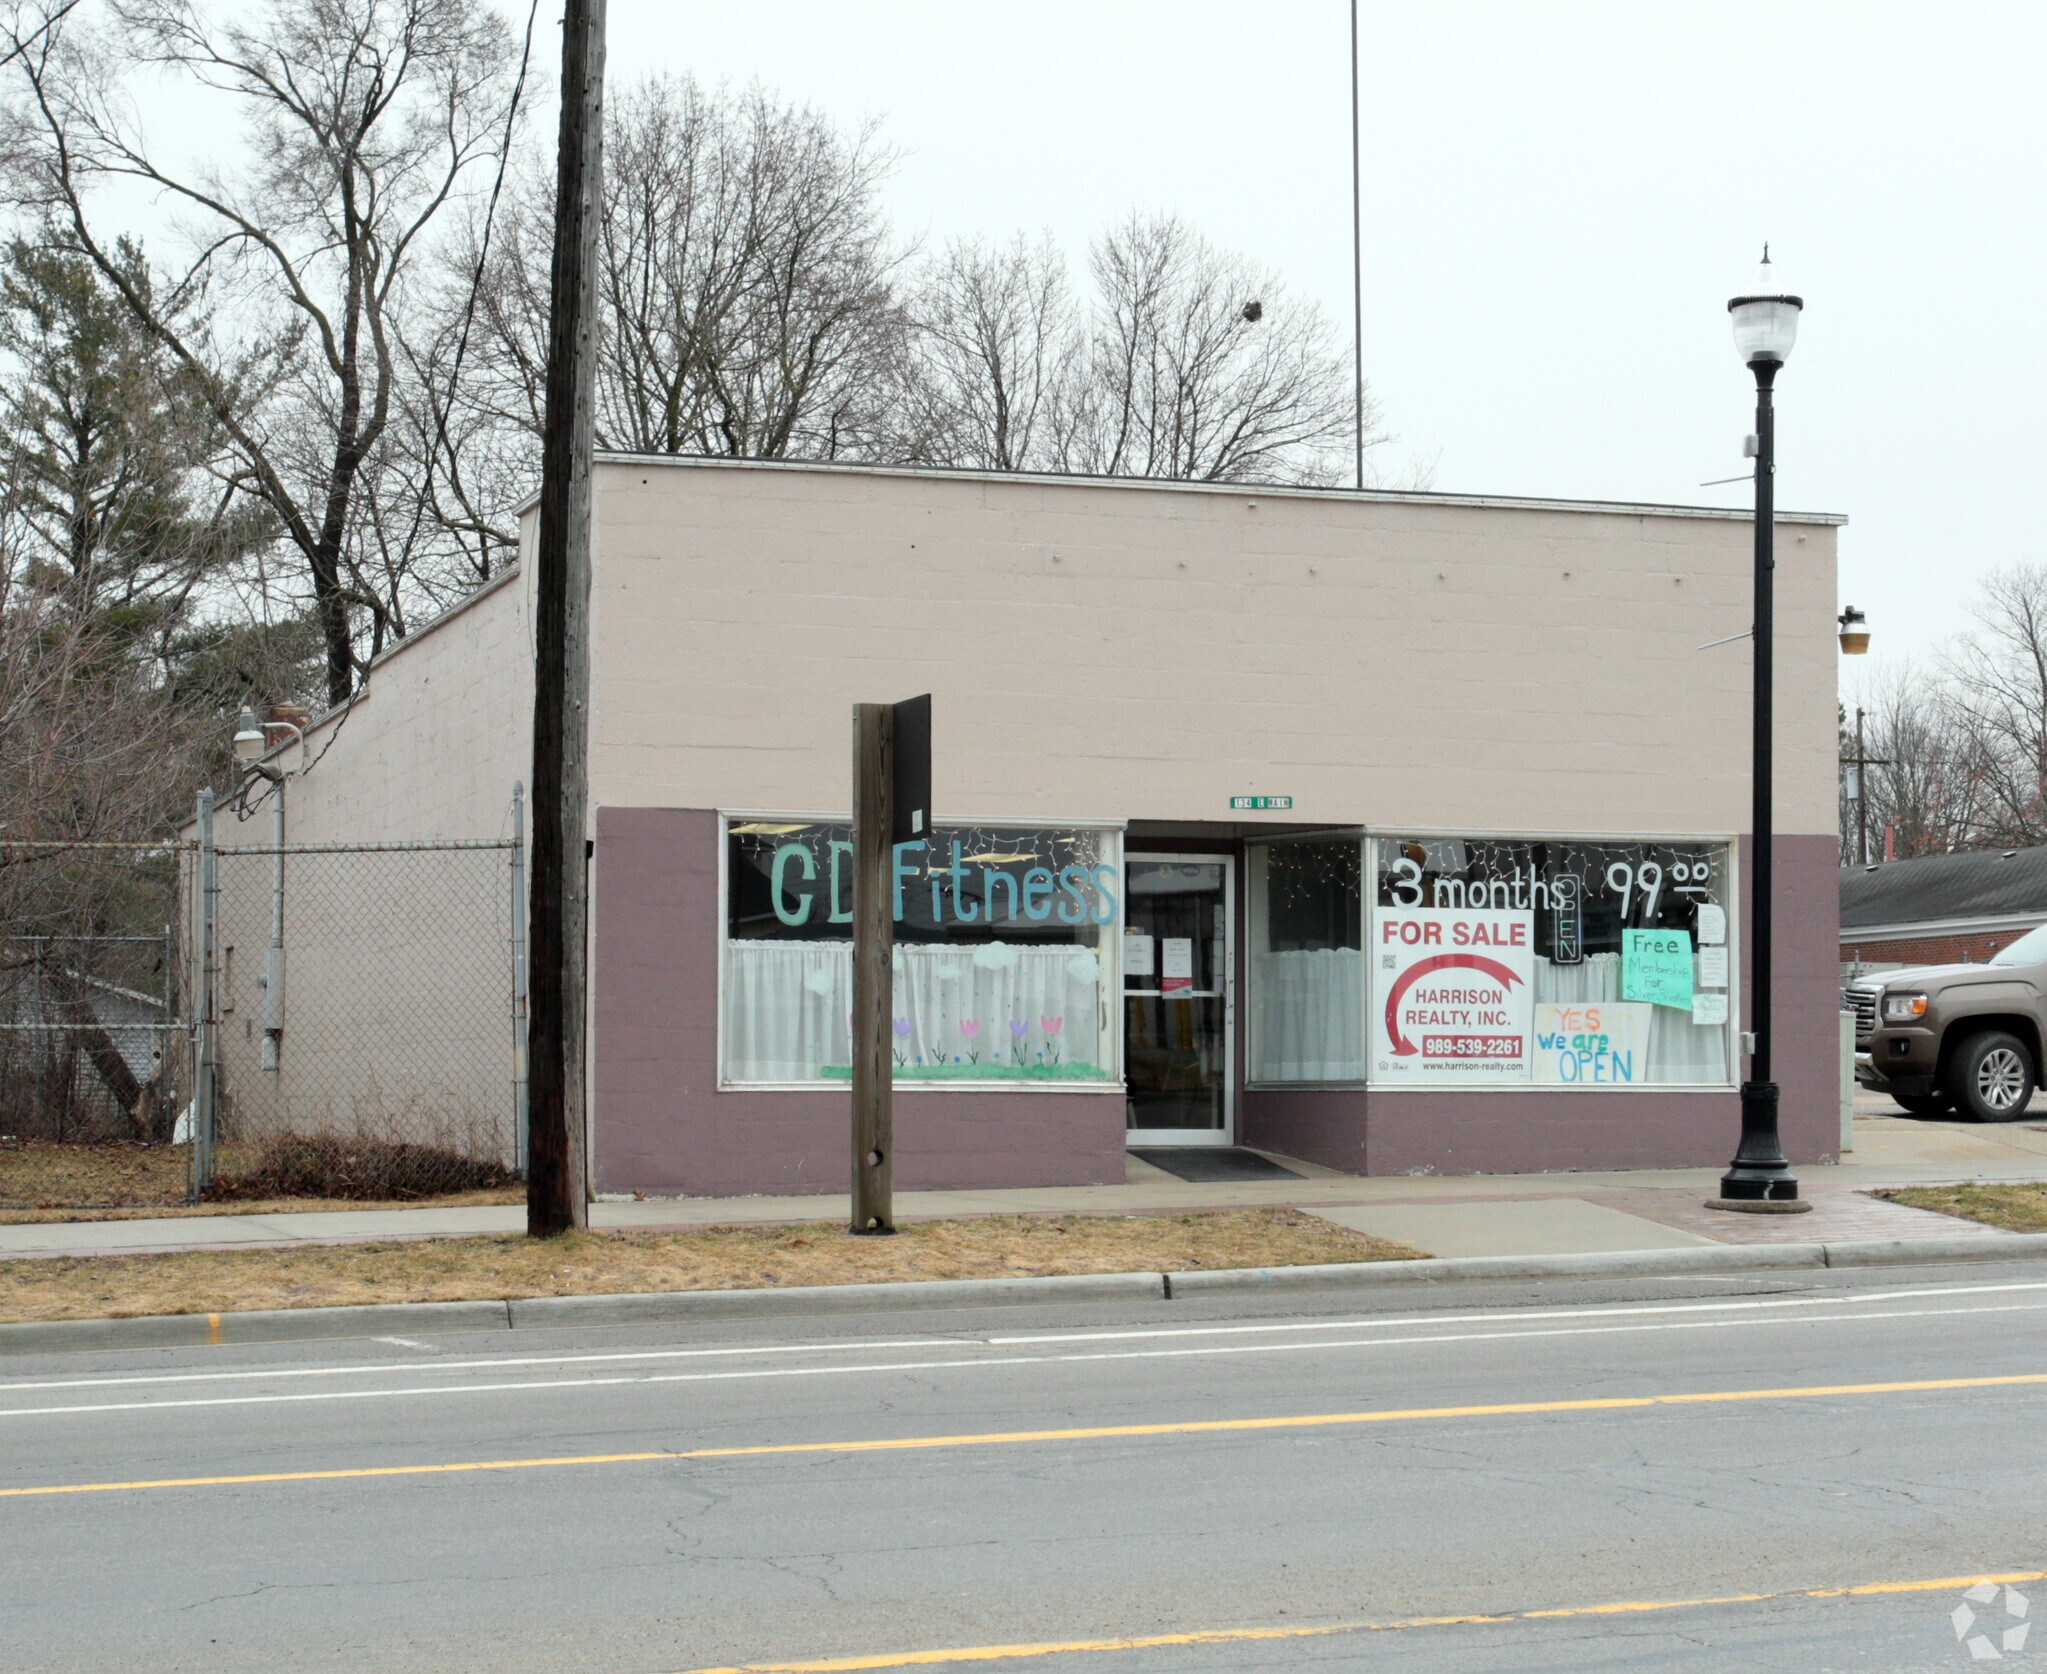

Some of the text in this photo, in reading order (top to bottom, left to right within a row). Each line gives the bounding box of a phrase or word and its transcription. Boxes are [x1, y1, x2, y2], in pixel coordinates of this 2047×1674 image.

[1268, 798, 1290, 808] MAIN
[892, 839, 1118, 926] Fitness
[1391, 857, 1424, 911] 3
[1434, 863, 1568, 911] months
[1383, 921, 1526, 946] FOR SALE
[1633, 934, 1679, 953] Free
[1415, 989, 1503, 1004] HARRISON
[1405, 1010, 1511, 1028] REALTY, INC.
[1555, 1008, 1601, 1031] YES
[1426, 1039, 1519, 1055] 989-539-2261
[1571, 1033, 1609, 1051] are
[1423, 1062, 1523, 1072] www.harrison-realty.com
[1559, 1049, 1632, 1082] OPEN
